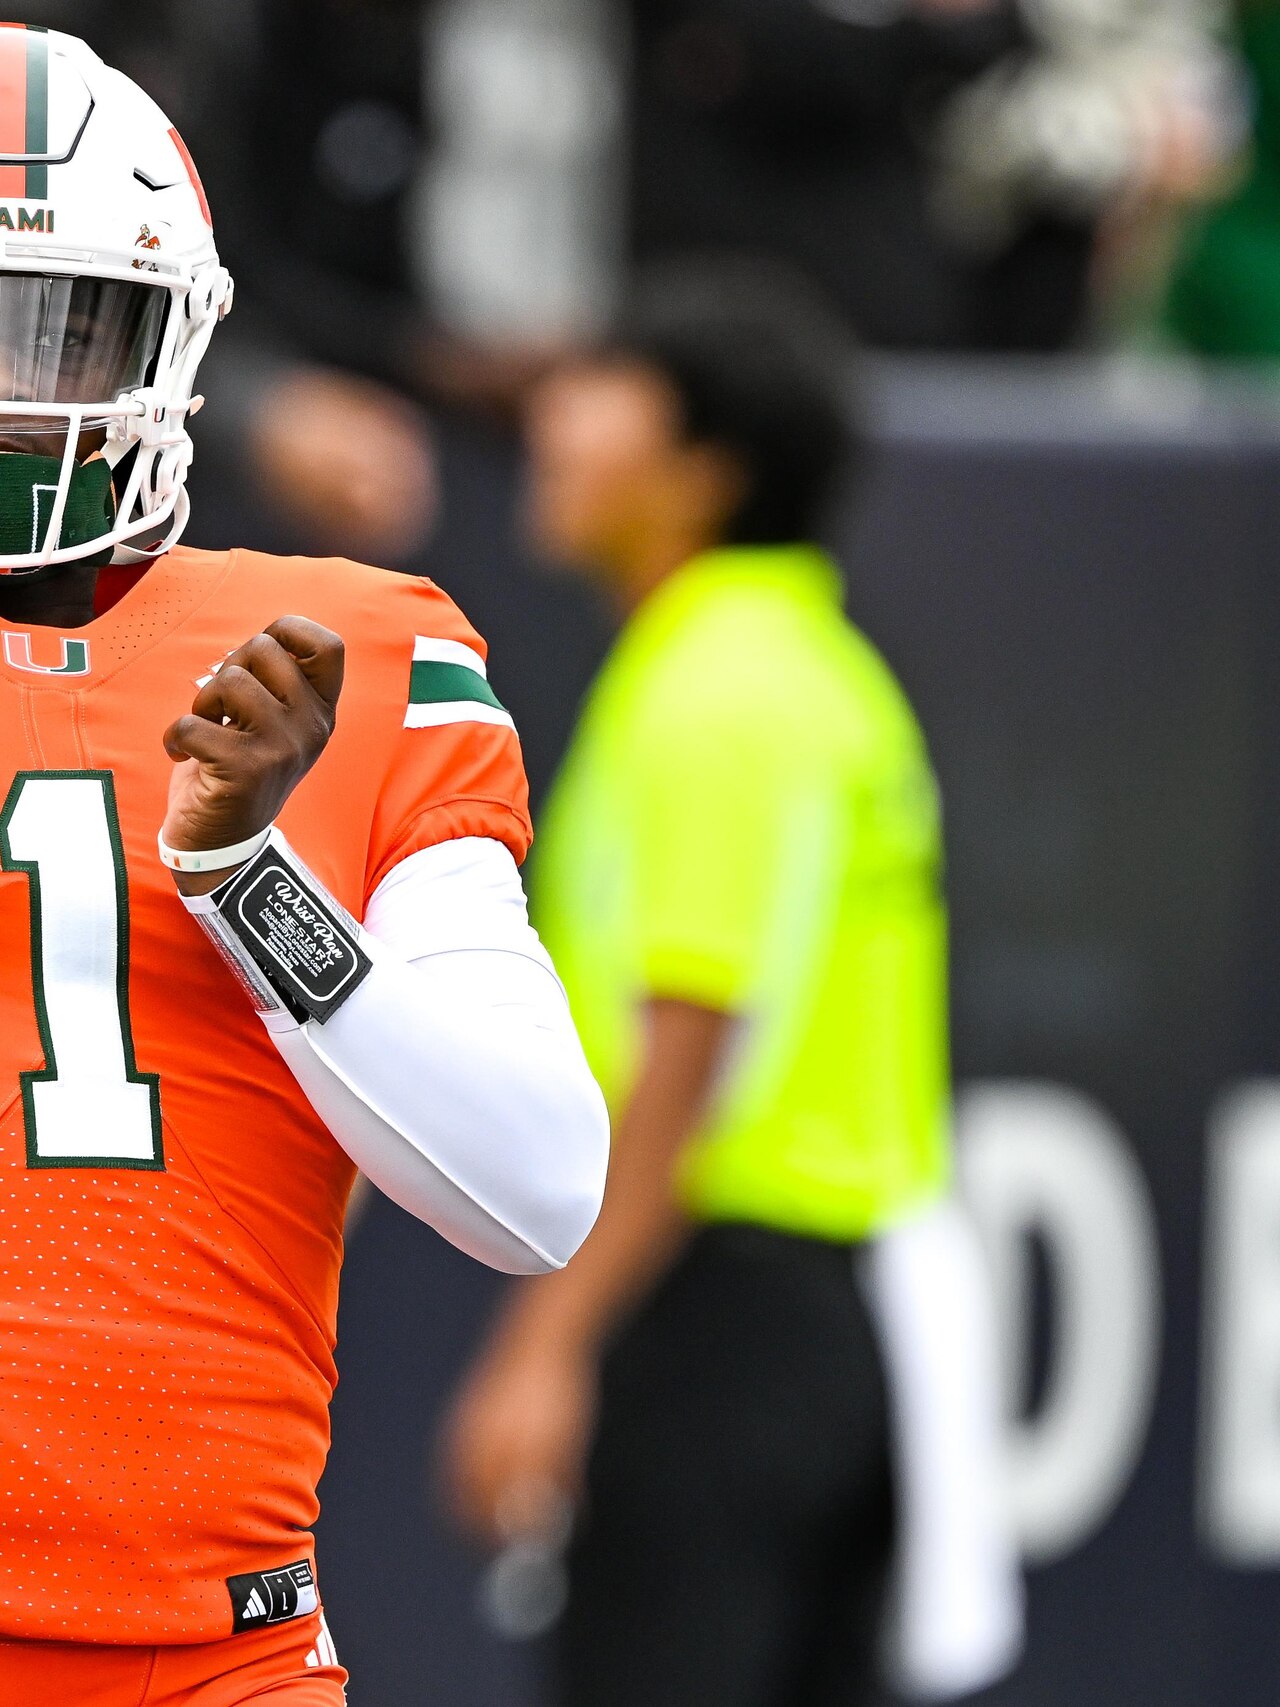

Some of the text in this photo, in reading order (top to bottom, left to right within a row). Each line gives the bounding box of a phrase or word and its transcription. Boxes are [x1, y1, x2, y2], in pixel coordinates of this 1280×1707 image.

[1, 629, 93, 677] U
[275, 881, 316, 923] Wrist
[266, 894, 329, 961] LONE STAR
